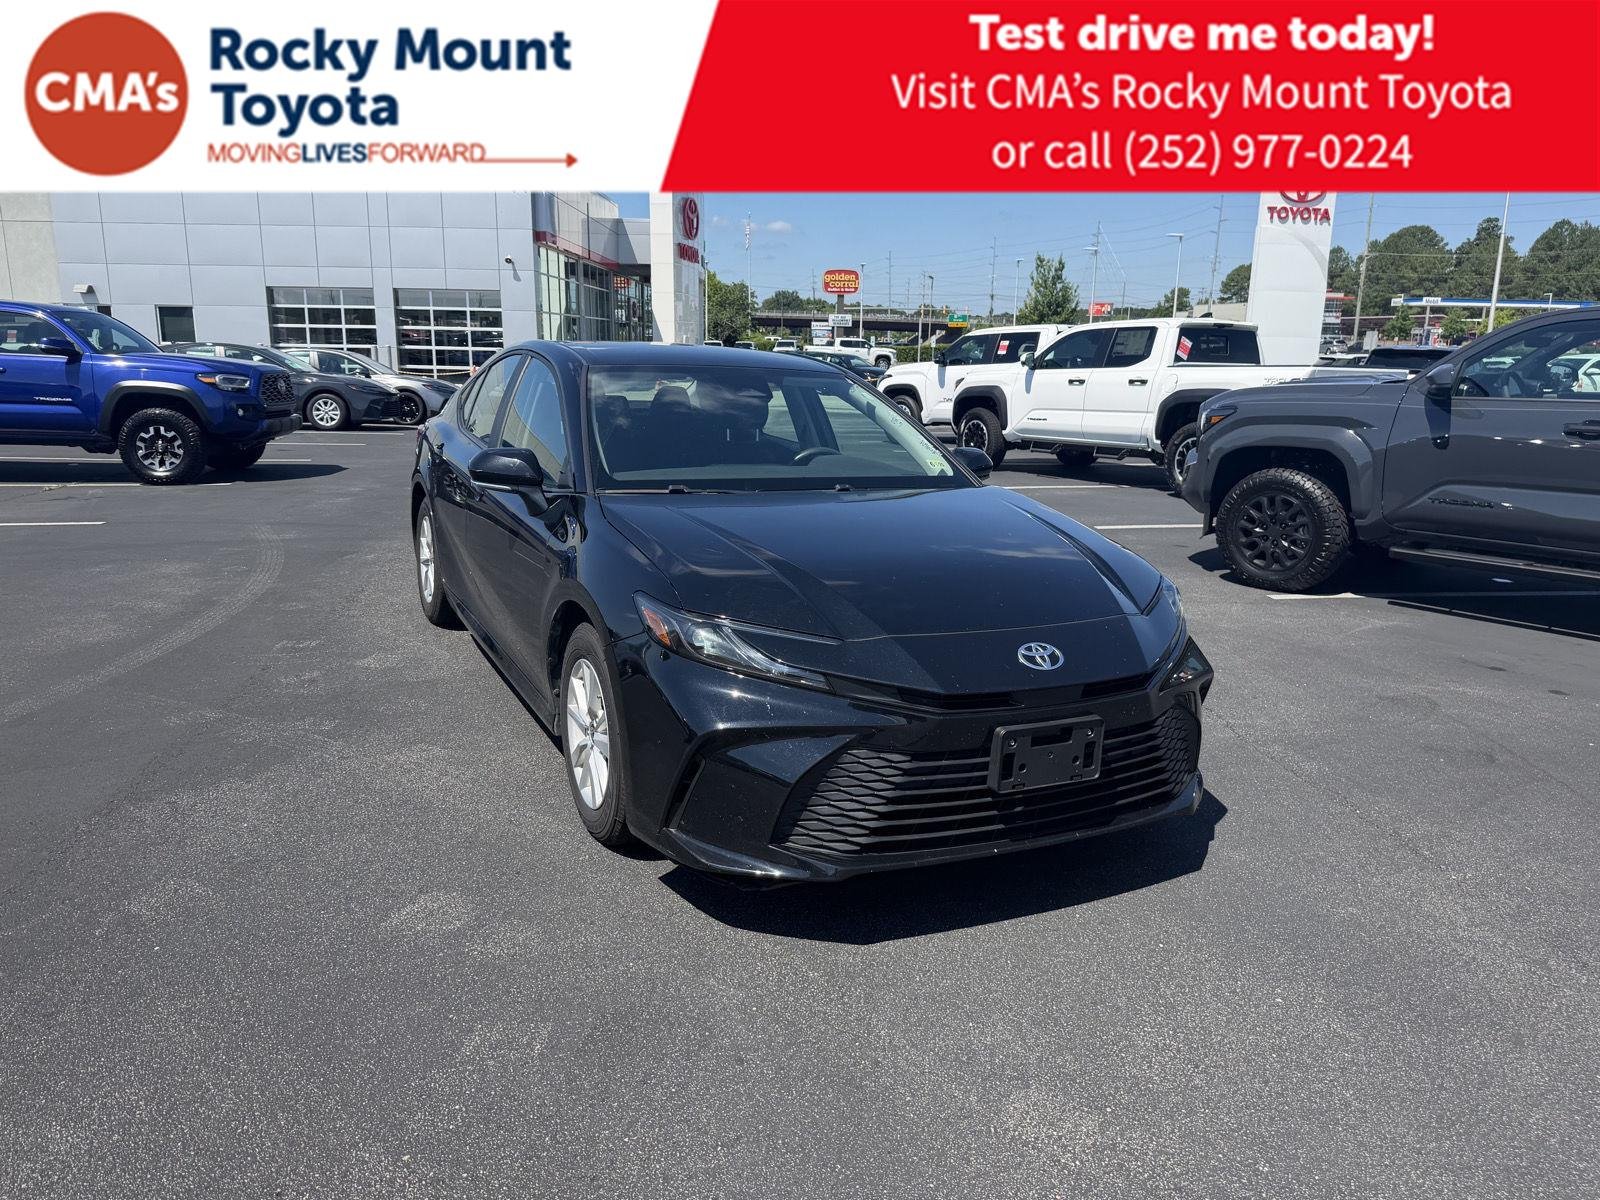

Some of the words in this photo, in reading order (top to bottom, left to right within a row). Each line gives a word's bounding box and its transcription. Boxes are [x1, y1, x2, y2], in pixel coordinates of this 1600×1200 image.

[1267, 206, 1331, 225] TOYOTA
[824, 273, 856, 283] golden
[829, 280, 859, 288] corral
